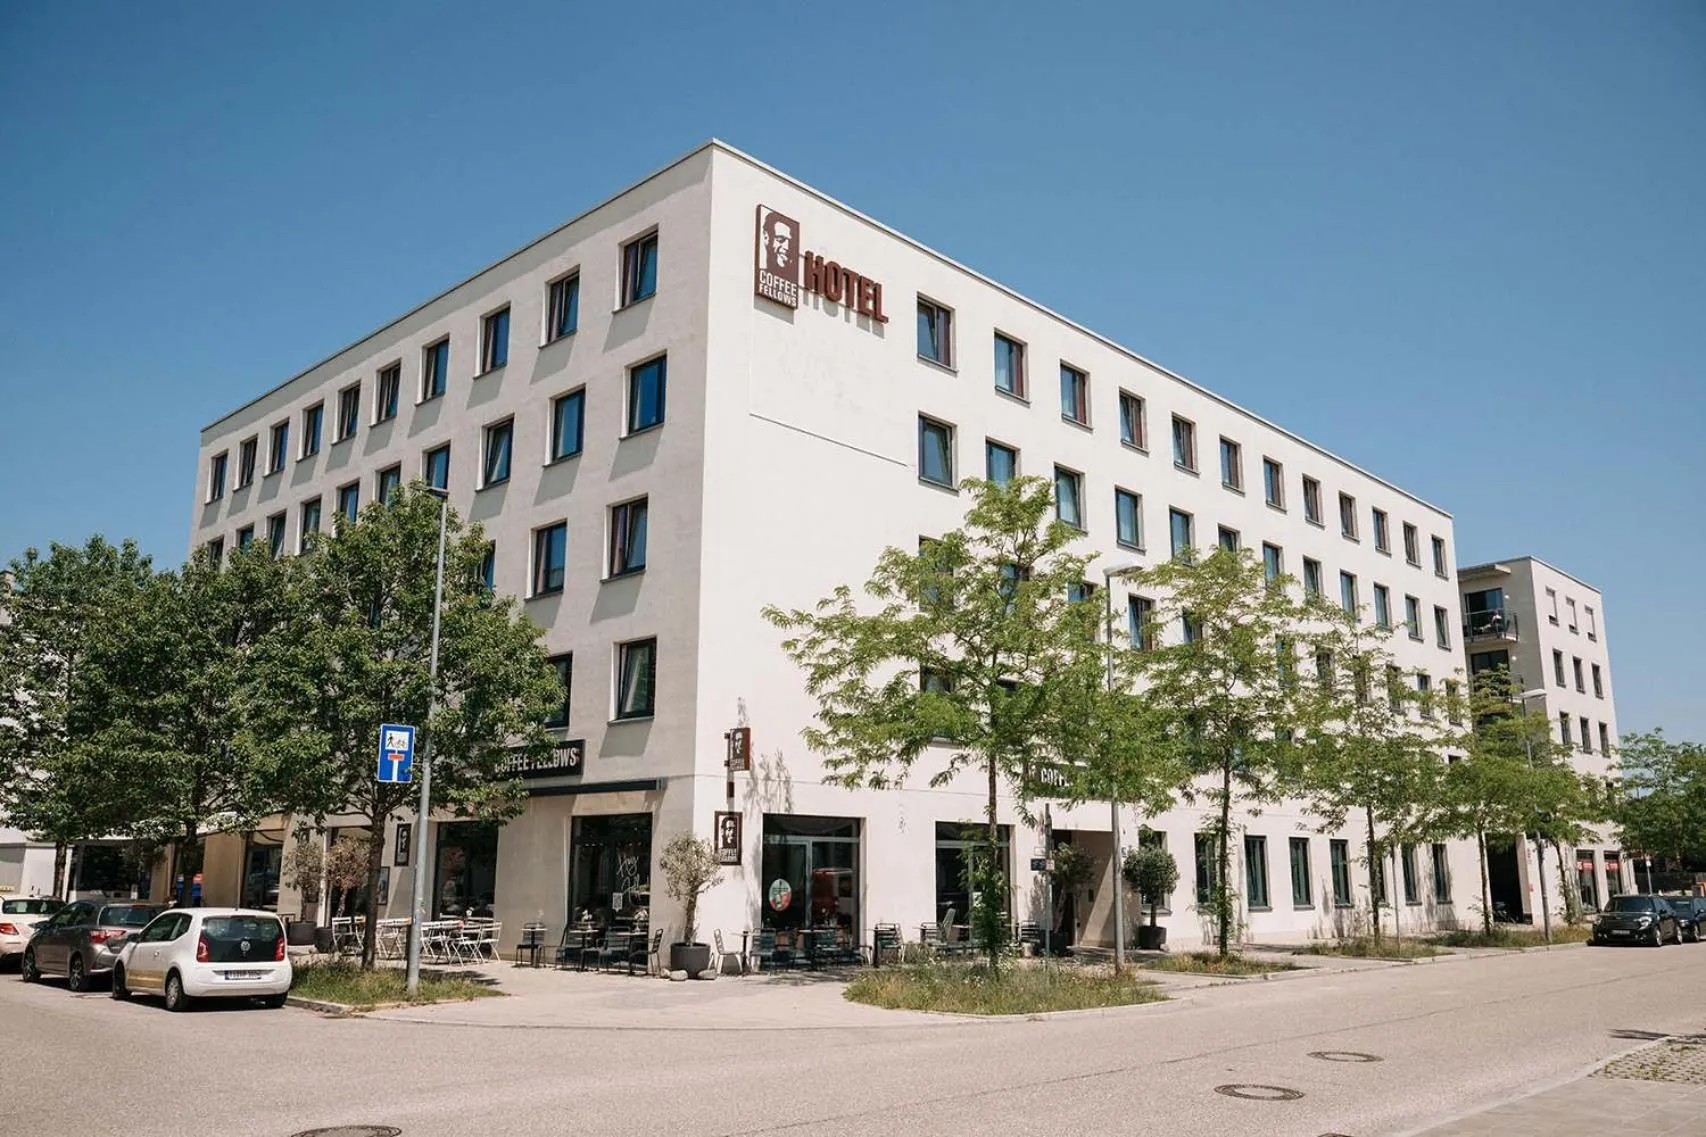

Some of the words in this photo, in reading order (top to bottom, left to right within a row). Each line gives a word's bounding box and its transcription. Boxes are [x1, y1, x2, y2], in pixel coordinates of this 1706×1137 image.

[759, 283, 797, 307] FELLOWS
[760, 270, 797, 297] COFFEE
[804, 250, 888, 323] HOTEL
